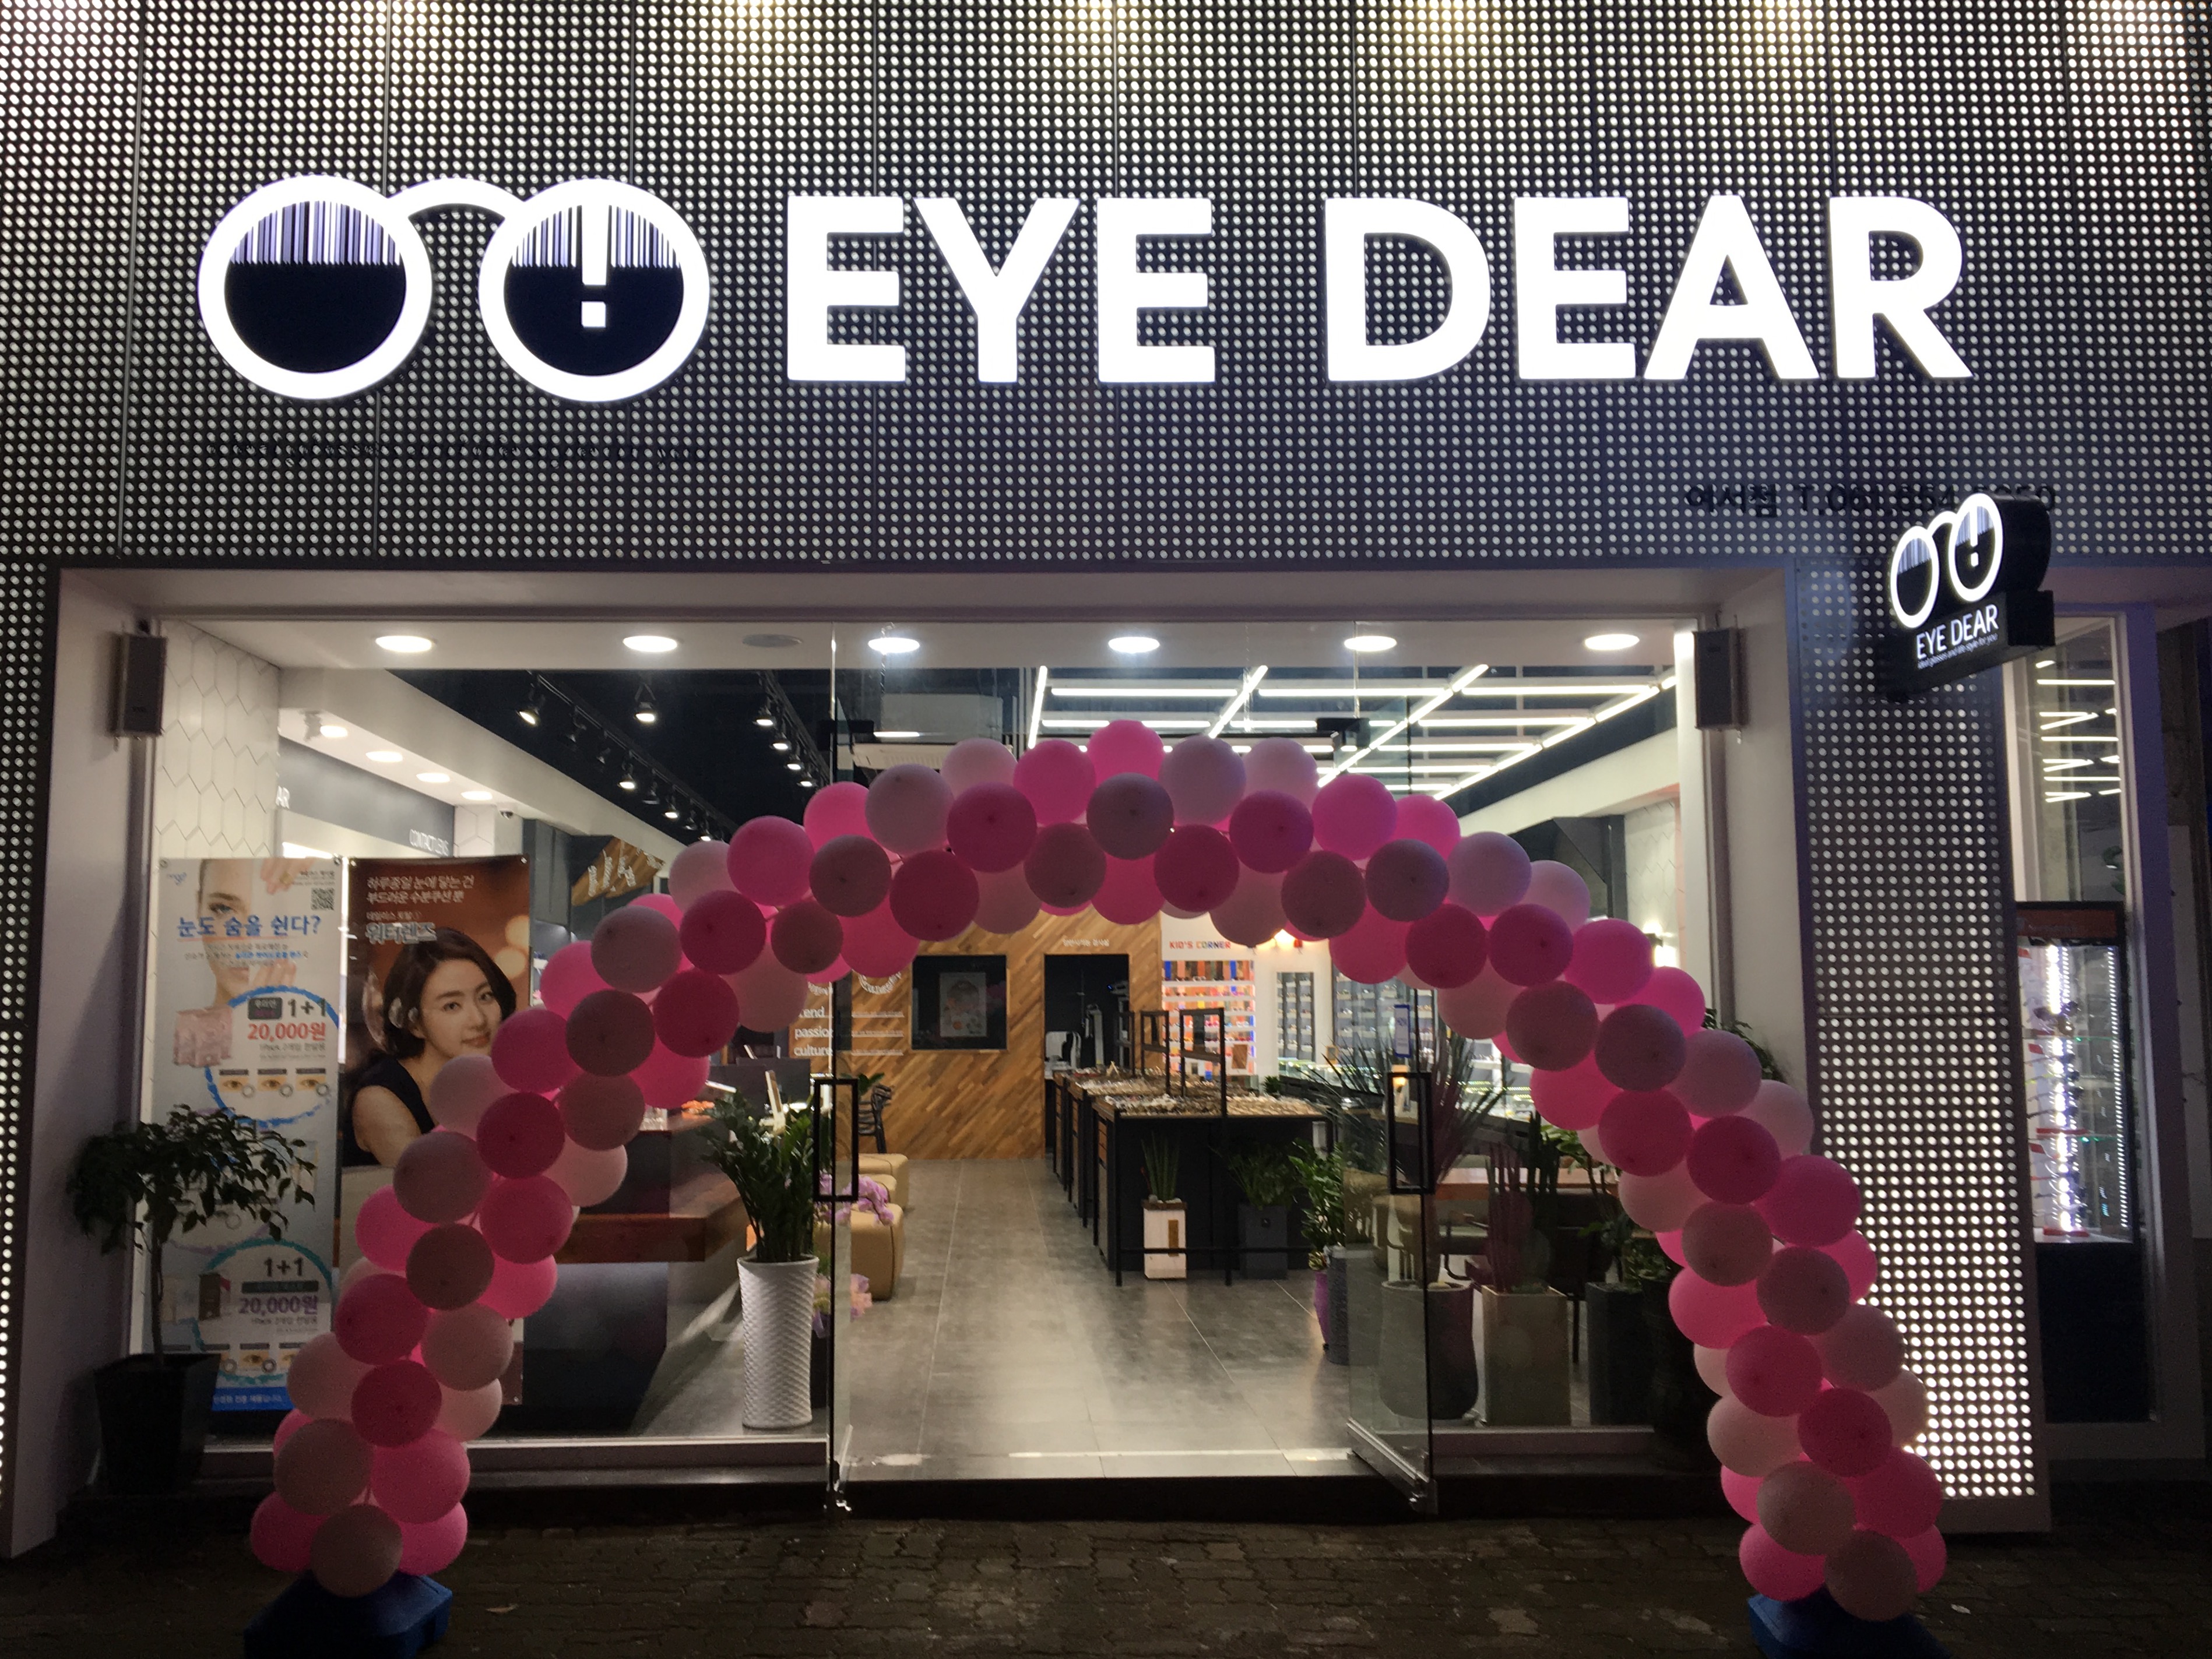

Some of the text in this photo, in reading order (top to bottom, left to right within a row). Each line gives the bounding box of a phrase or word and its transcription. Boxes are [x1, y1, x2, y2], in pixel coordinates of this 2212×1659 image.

[787, 189, 1972, 383] EYE DEAR
[1916, 604, 1999, 659] EYE DEAR
[177, 914, 322, 937] 눈도 숨을 쉰다?
[1169, 941, 1231, 949] KID'S CORNER
[287, 998, 326, 1017] 1+1
[799, 1006, 825, 1018] end
[248, 1022, 326, 1042] 20,000원
[264, 1257, 303, 1277] 1+1
[238, 1295, 318, 1316] 20,000원
